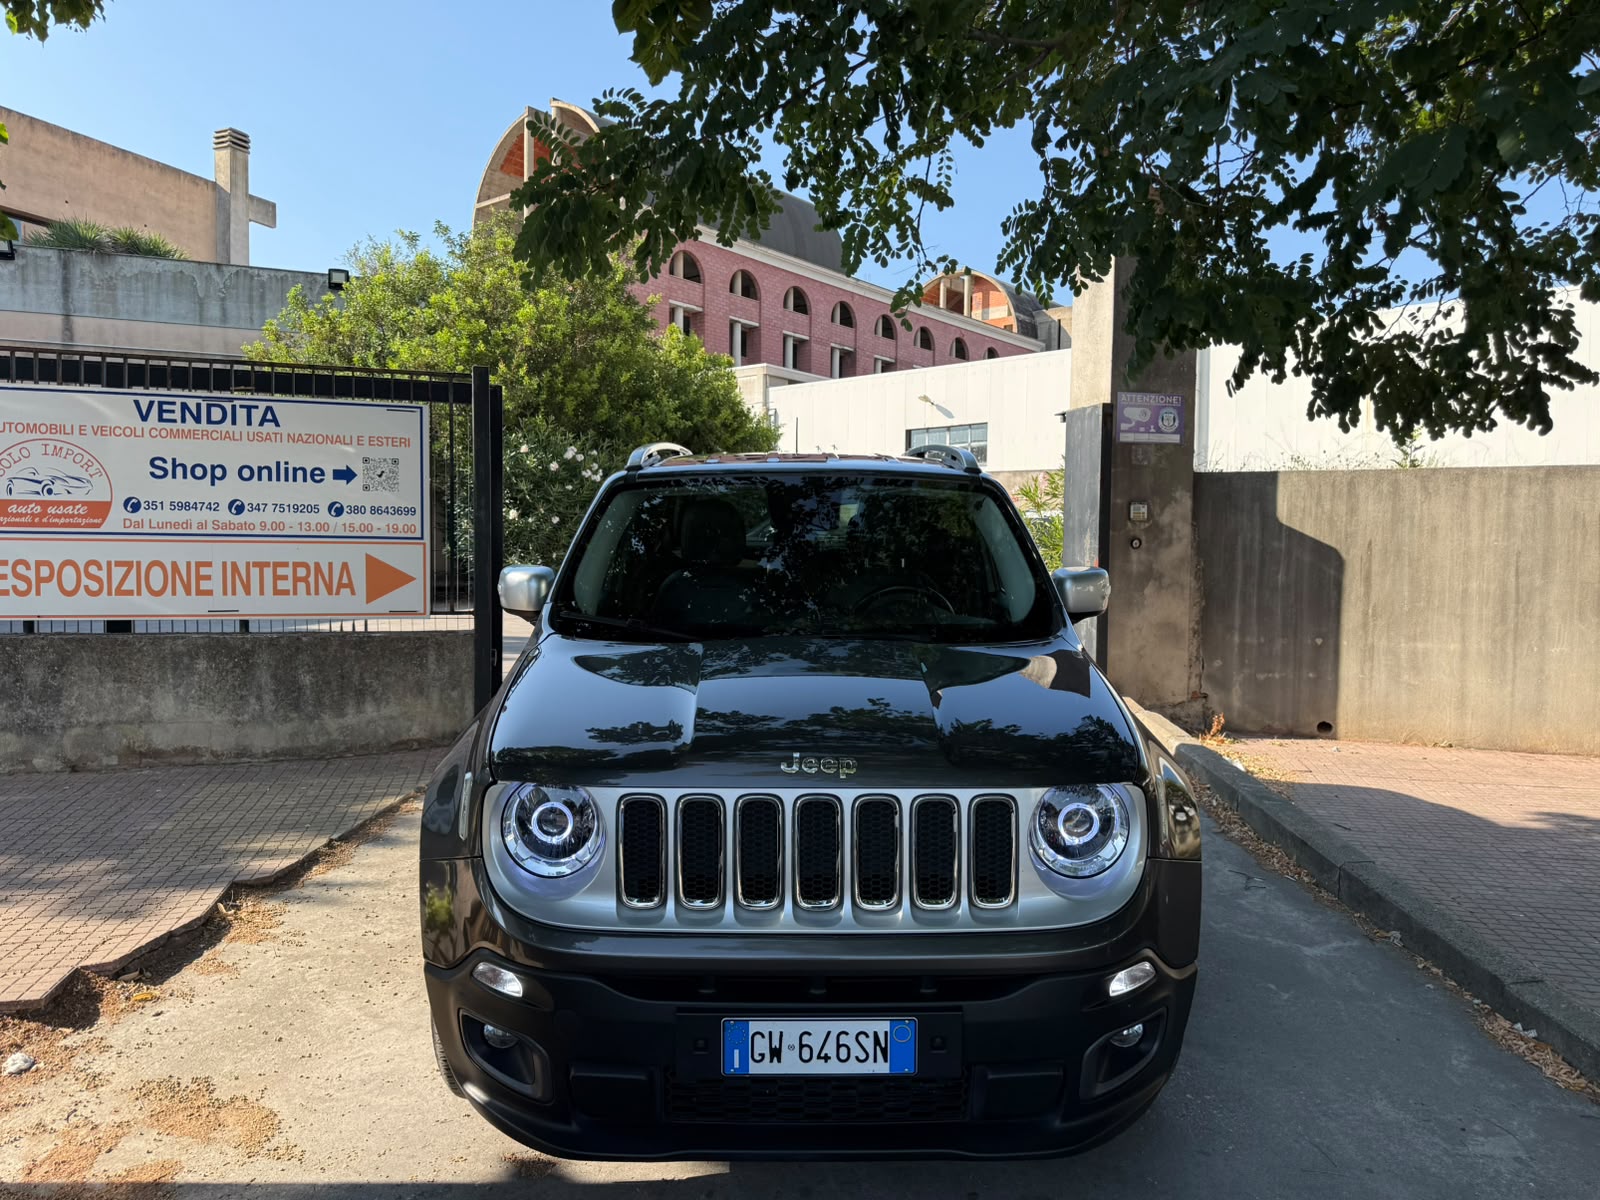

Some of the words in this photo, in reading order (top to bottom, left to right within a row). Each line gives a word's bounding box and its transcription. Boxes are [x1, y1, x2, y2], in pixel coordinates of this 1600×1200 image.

[1121, 394, 1182, 405] ATTENZIONE!
[133, 399, 281, 428] VENDITA
[79, 425, 88, 436] E
[91, 425, 144, 439] VEICOLI
[148, 427, 242, 442] COMMERCIALI
[246, 431, 283, 443] USATI
[287, 432, 353, 446] NAZIONALI
[356, 435, 365, 446] E
[368, 436, 411, 449] ESTERI
[41, 443, 104, 478] IMPORT
[149, 456, 228, 487] Shop
[237, 461, 326, 484] online
[7, 502, 42, 514] auto
[47, 503, 88, 515] usate
[143, 500, 165, 511] 351
[169, 501, 220, 512] 5984742
[247, 502, 268, 513] 347
[271, 503, 320, 514] 7519205
[345, 505, 367, 515] 380
[369, 505, 417, 516] 8643699
[123, 518, 144, 529] Dal
[148, 518, 193, 530] Lunedì
[196, 520, 208, 531] al
[211, 520, 256, 531] Sabato
[259, 521, 286, 532] 9.00
[297, 522, 330, 533] 13.00
[341, 522, 374, 533] 15.00
[385, 523, 417, 534] 19.00
[221, 561, 356, 596] INTERNA
[780, 752, 858, 779] Jeep
